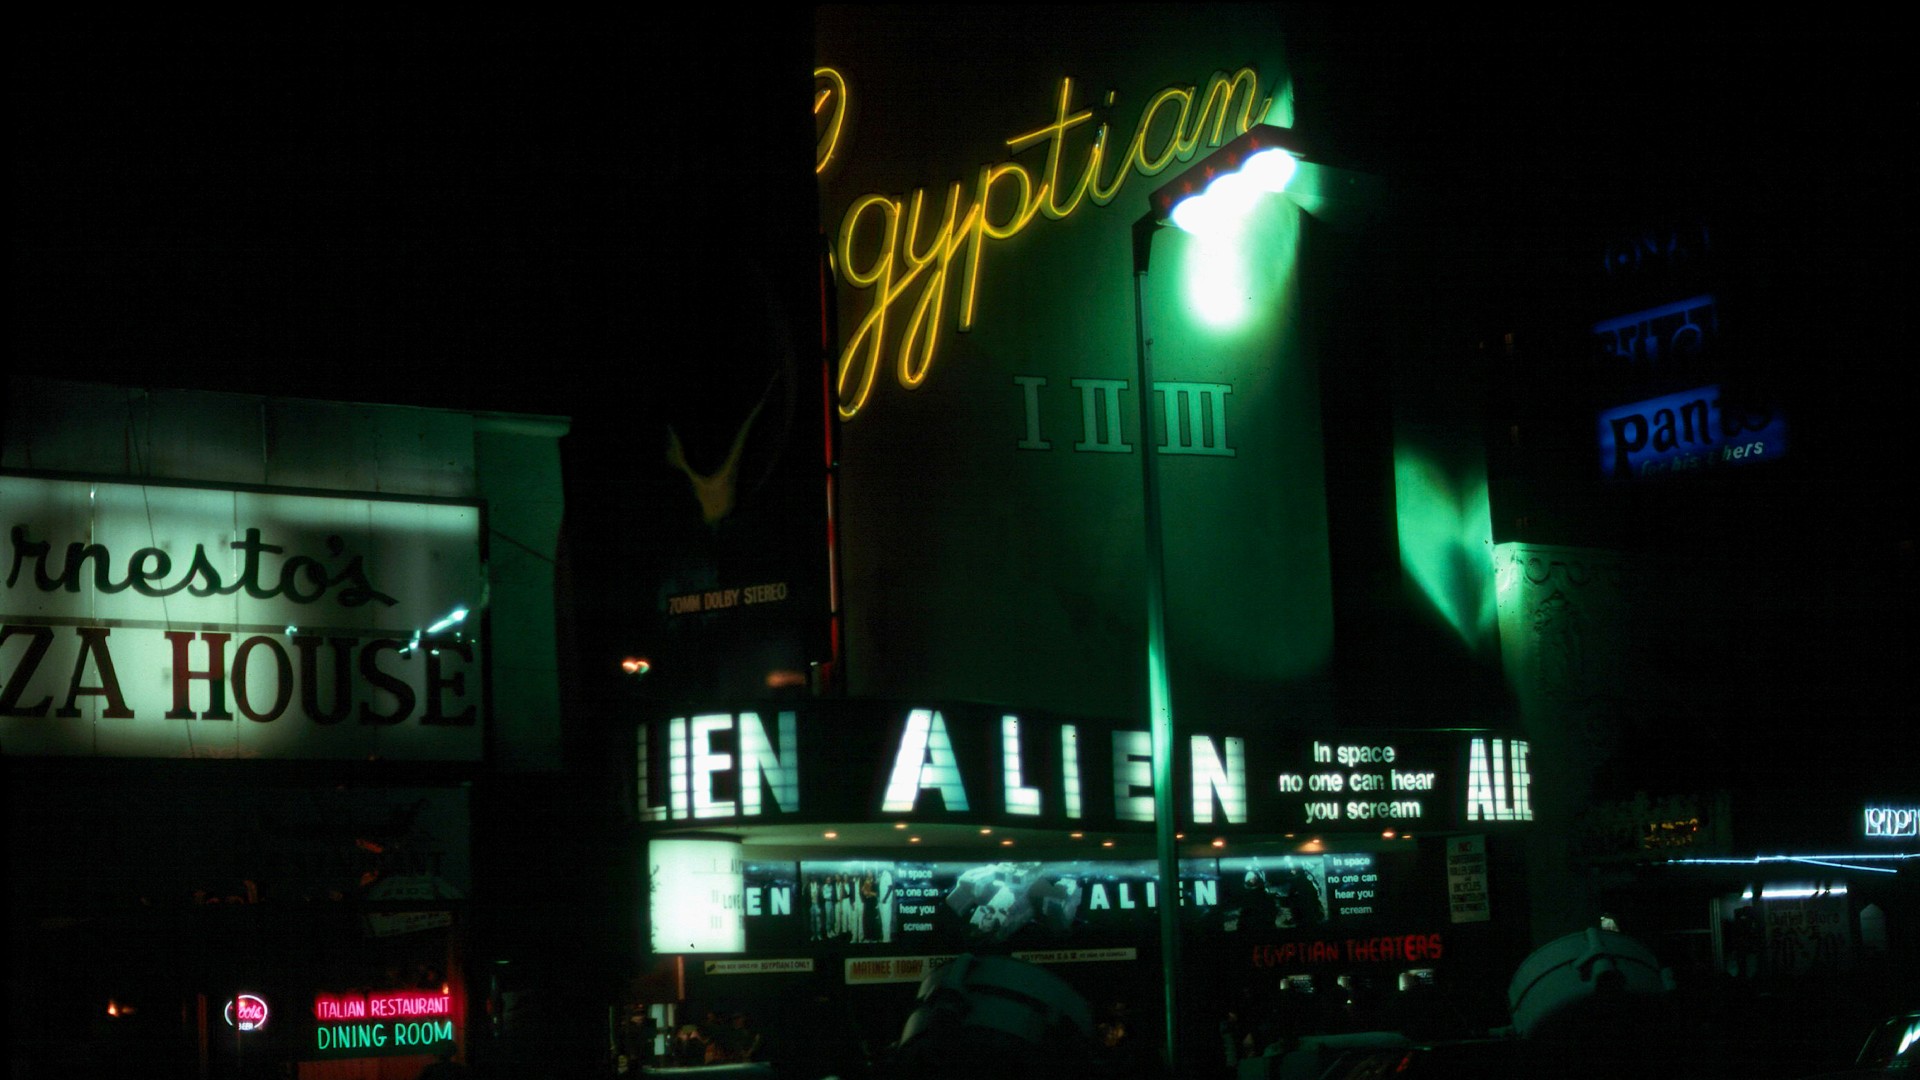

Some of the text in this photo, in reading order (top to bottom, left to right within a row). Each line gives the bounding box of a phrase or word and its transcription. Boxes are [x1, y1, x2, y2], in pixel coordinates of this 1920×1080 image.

[814, 65, 1273, 421] gyptian
[1013, 375, 1238, 457] I II III
[1722, 441, 1764, 462] hers
[703, 589, 740, 611] DOLBY
[743, 581, 787, 606] STEREO
[165, 630, 477, 727] HOUSE
[637, 710, 800, 822] LIEN
[881, 708, 1248, 824] ALIEN
[1313, 741, 1396, 768] In space
[1279, 769, 1435, 792] no one can hear
[1304, 799, 1421, 824] you scream
[1344, 857, 1371, 868] space
[1328, 874, 1378, 884] no one can
[746, 887, 791, 916] EN
[906, 888, 922, 897] one
[923, 888, 939, 897] can
[1089, 880, 1217, 910] ALIN
[1335, 889, 1374, 901] hear you
[899, 903, 936, 916] hear you
[1340, 906, 1373, 915] scream
[903, 922, 933, 931] scream
[1344, 932, 1444, 961] THEATERS
[317, 996, 450, 1019] ITALIAN RESTAURANT
[317, 1020, 453, 1050] DINING ROOM
